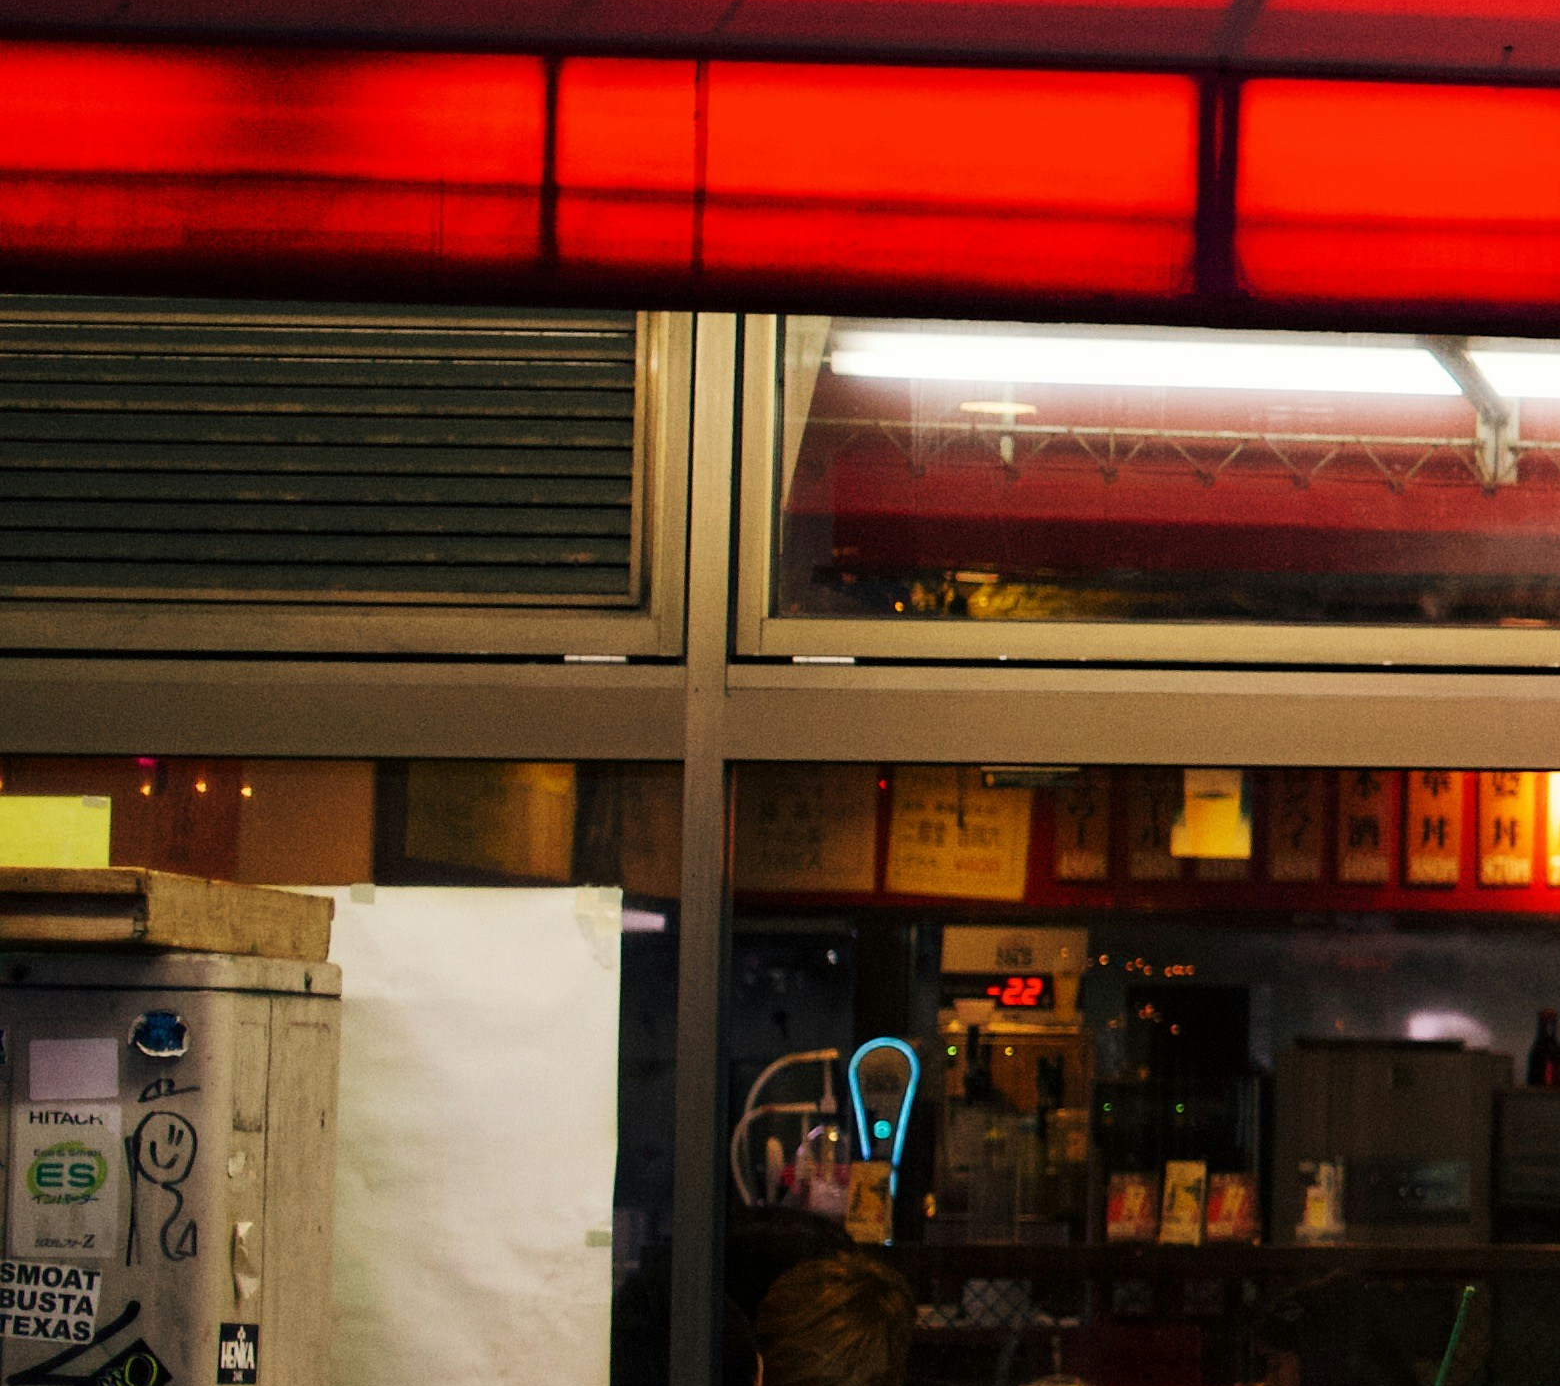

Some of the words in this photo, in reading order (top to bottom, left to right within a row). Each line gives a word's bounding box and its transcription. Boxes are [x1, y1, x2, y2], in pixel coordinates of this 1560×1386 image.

[36, 1163, 96, 1188] ES
[0, 1288, 94, 1316] BUSTA
[0, 1315, 91, 1342] TEXAS
